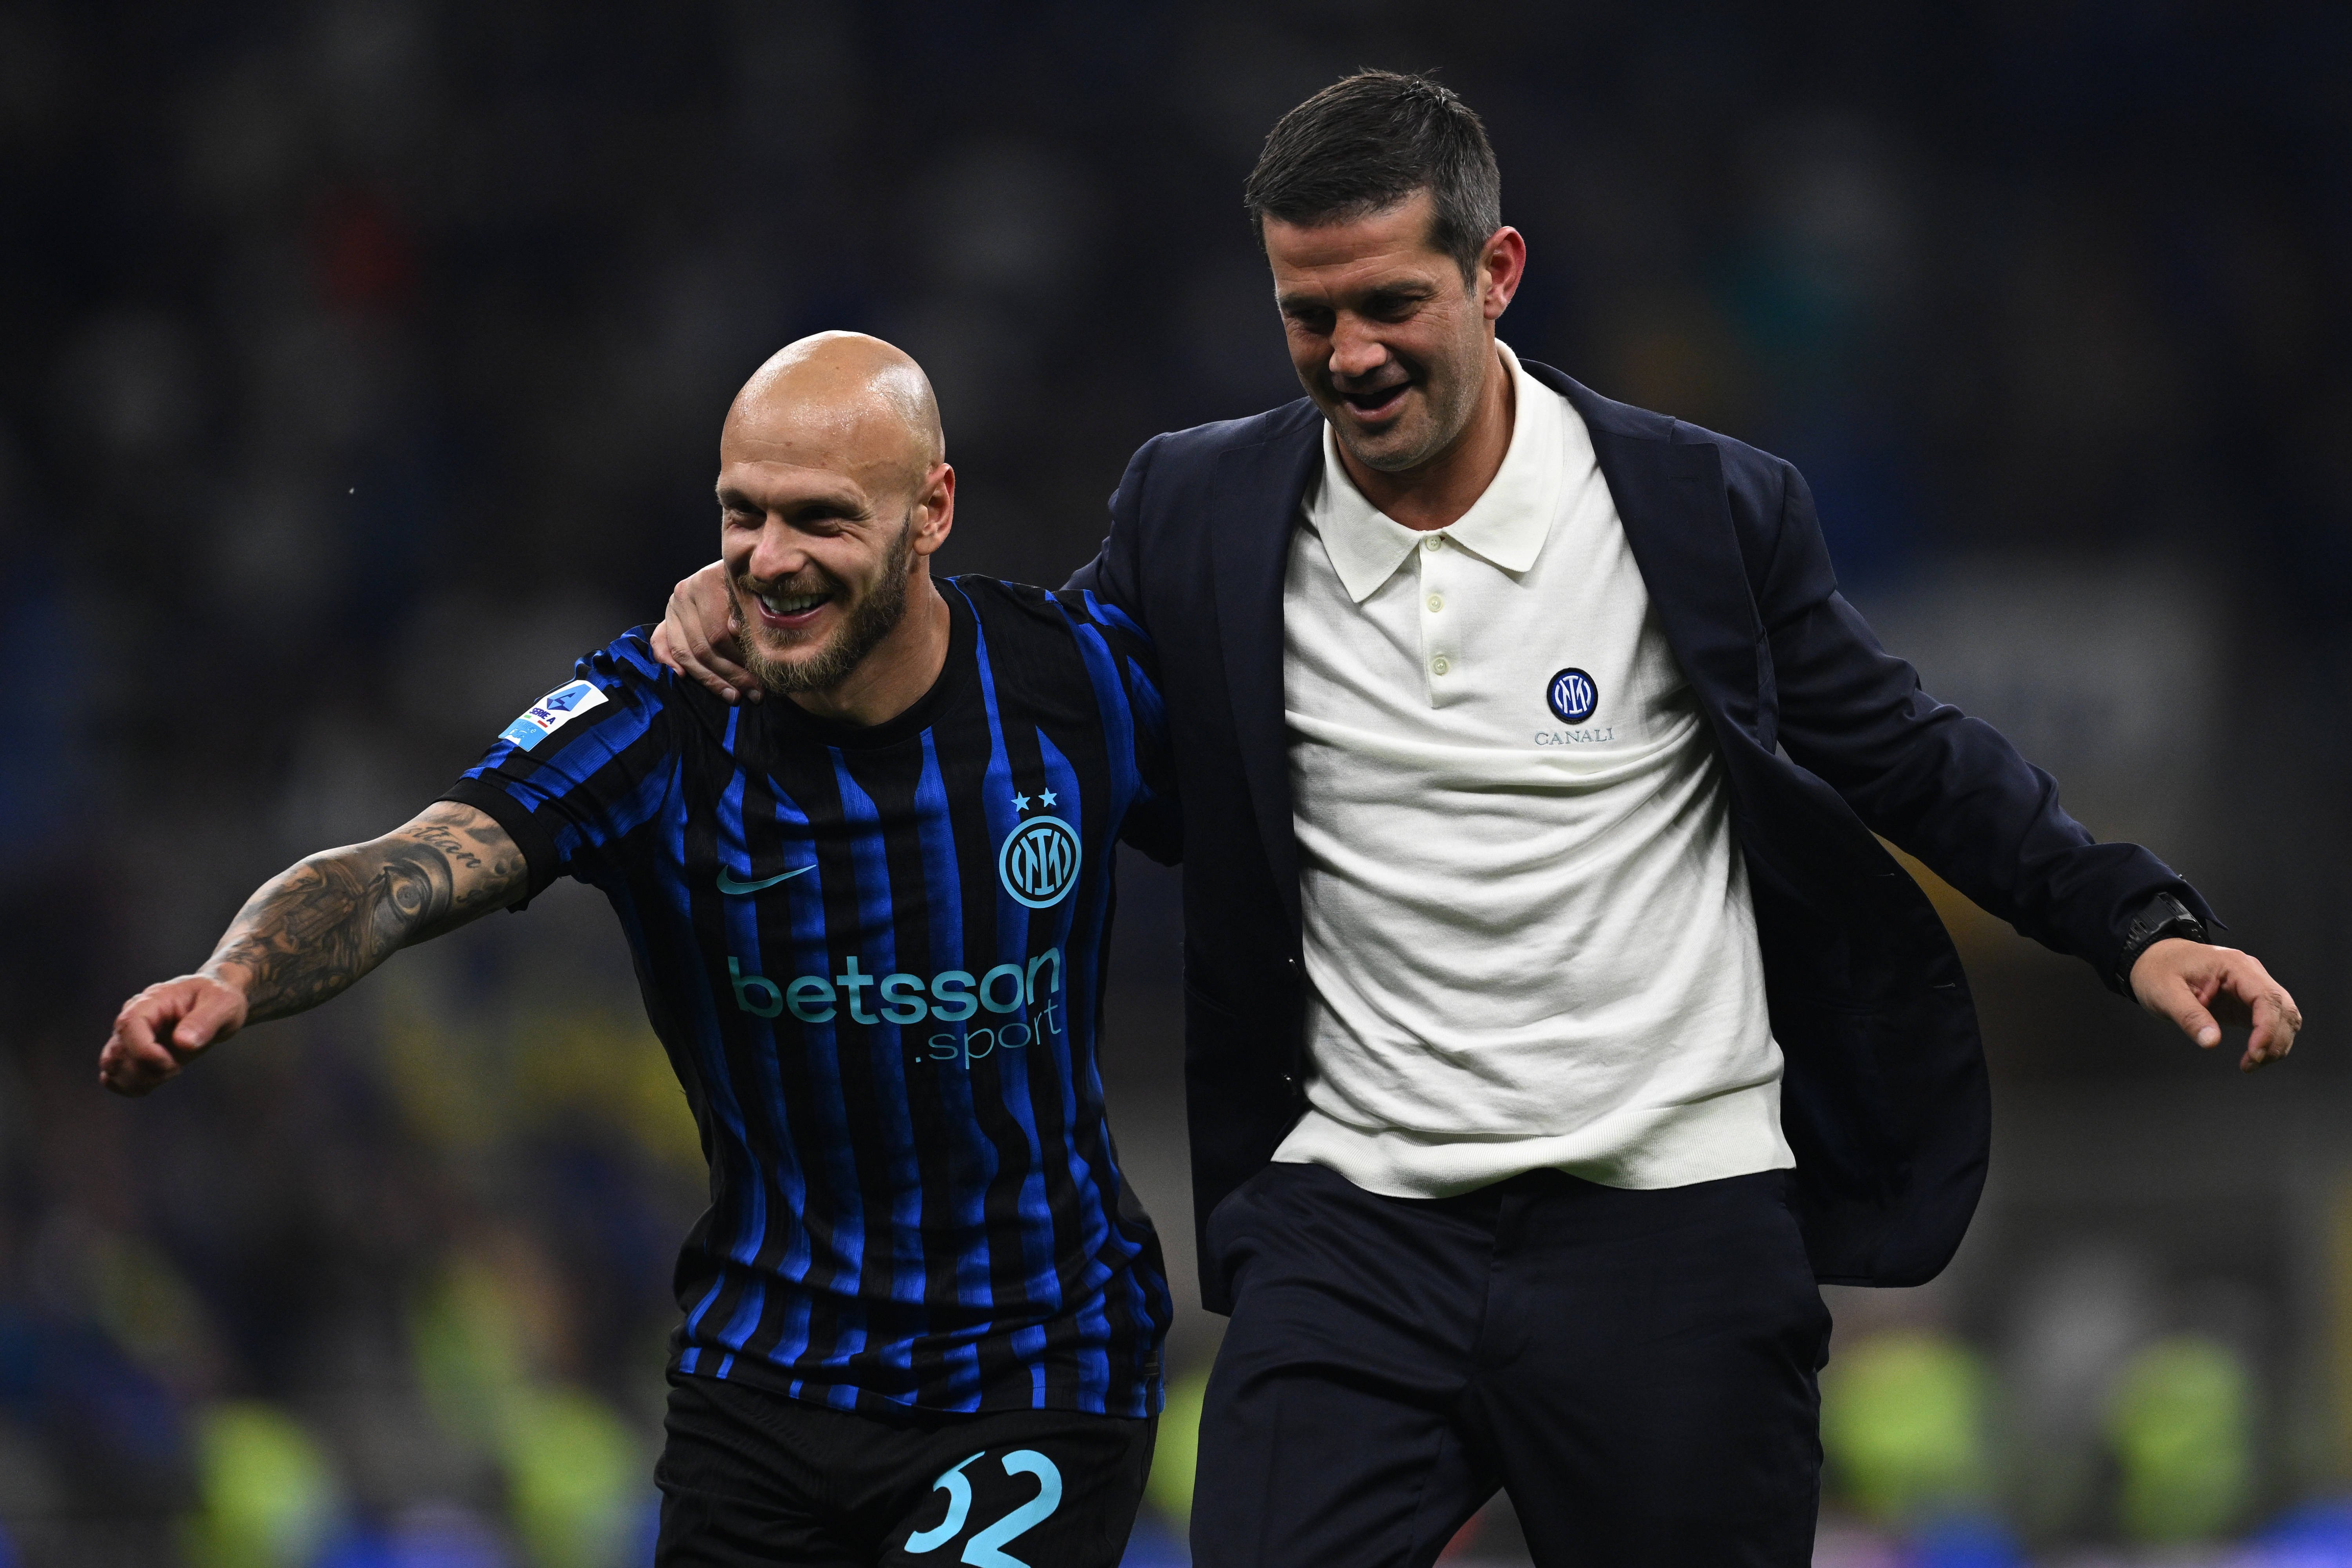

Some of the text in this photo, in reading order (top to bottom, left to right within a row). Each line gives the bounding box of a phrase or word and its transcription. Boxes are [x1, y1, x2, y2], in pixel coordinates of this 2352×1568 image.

[529, 707, 551, 719] SERIE
[1535, 727, 1614, 745] CANALI
[728, 947, 1060, 1024] betsson
[916, 999, 1062, 1069] .sport
